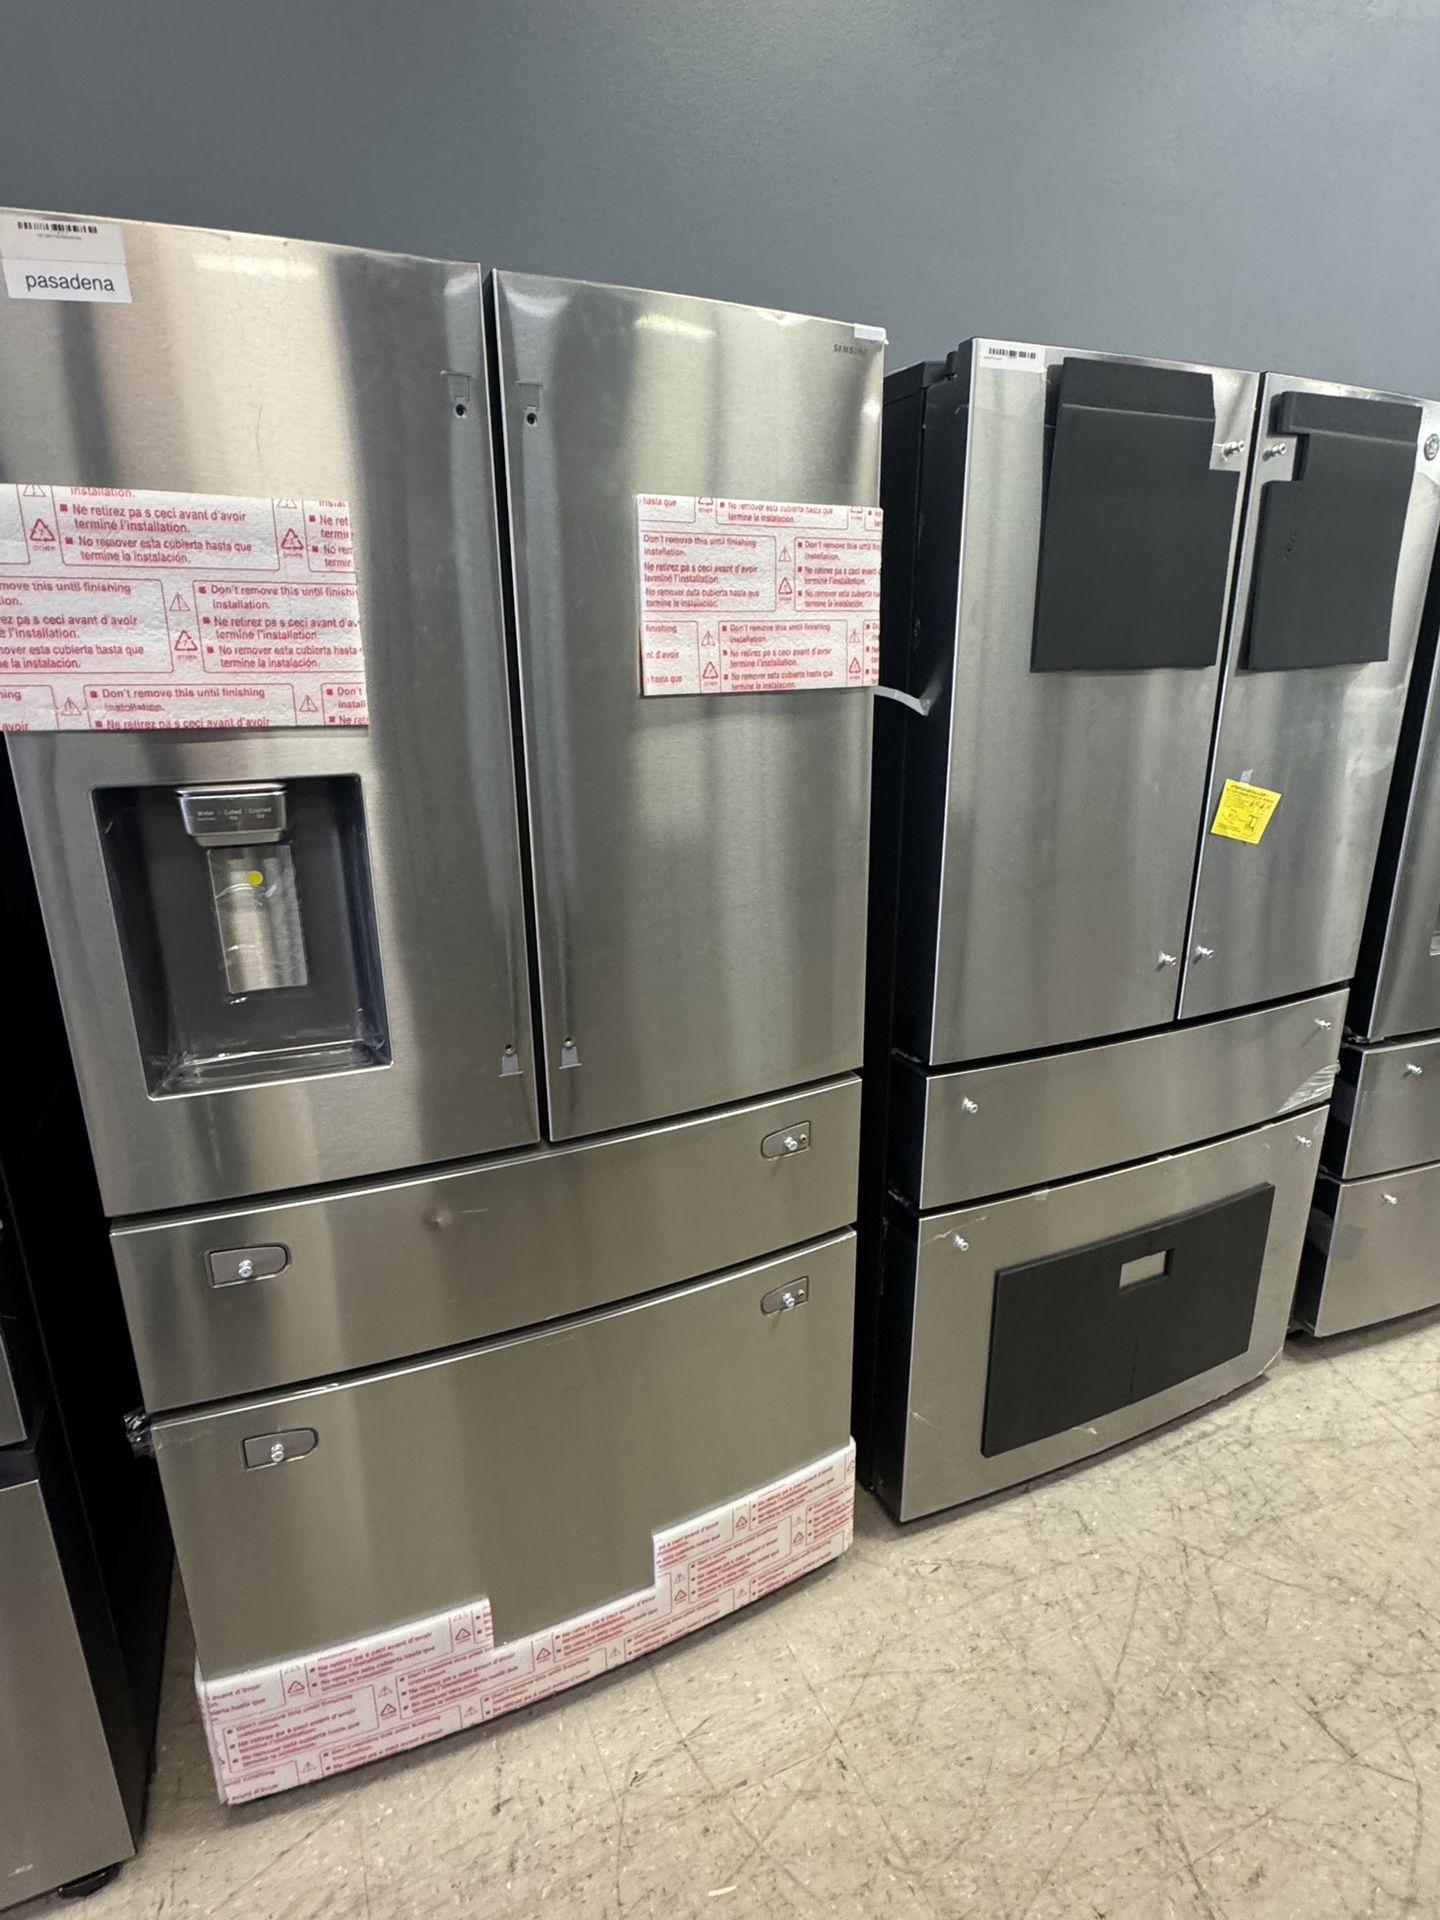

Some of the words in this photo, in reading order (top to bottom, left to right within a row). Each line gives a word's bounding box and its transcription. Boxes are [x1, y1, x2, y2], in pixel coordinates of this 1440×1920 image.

[25, 273, 115, 292] pasadena
[70, 487, 136, 498] installation.
[72, 503, 88, 515] Ne
[90, 504, 126, 517] retirez
[128, 507, 142, 519] pa
[144, 508, 152, 518] s
[154, 507, 176, 519] ceci
[178, 509, 208, 520] avant
[210, 509, 246, 521] d'avoir
[120, 519, 191, 533] l'installation.
[78, 536, 93, 547] No
[96, 538, 137, 548] remover
[139, 539, 161, 549] esta
[163, 539, 203, 551] cubierta
[205, 539, 232, 552] hasta
[233, 542, 253, 554] que
[643, 534, 663, 543] Don't
[665, 536, 693, 544] remove
[694, 536, 708, 545] this
[709, 537, 726, 545] until
[726, 538, 757, 548] finishing
[80, 549, 120, 561] termine
[121, 550, 131, 561] la
[643, 562, 654, 571] Ne
[655, 563, 679, 572] retirez
[713, 564, 733, 573] avant
[32, 581, 53, 591] this
[55, 581, 81, 592] until
[83, 581, 131, 595] finishing
[210, 584, 238, 594] Don't
[240, 586, 278, 596] remove
[280, 585, 299, 596] this
[301, 586, 323, 597] until
[212, 598, 271, 610] installation.
[16, 615, 30, 627] pa
[33, 615, 40, 625] s
[42, 614, 65, 625] ceci
[67, 615, 98, 625] avant
[100, 615, 138, 625] d'avoir
[213, 616, 228, 627] Ne
[230, 616, 262, 627] retirez
[264, 618, 277, 630] pa
[279, 618, 286, 627] s
[287, 617, 308, 628] ceci
[310, 618, 337, 628] avant
[8, 628, 80, 639] l'installation.
[29, 645, 51, 655] esta
[52, 645, 94, 655] cubierta
[95, 645, 123, 656] hasta
[125, 646, 144, 657] que
[218, 645, 233, 655] No
[234, 646, 272, 655] remover
[274, 646, 294, 655] esta
[295, 645, 332, 655] cubierta
[333, 646, 358, 656] hasta
[10, 657, 21, 668] la
[220, 658, 255, 668] termine
[257, 658, 266, 668] la
[102, 688, 131, 698] Don't
[133, 689, 173, 698] remove
[174, 687, 195, 698] this
[196, 687, 220, 698] until
[222, 686, 265, 699] finishing
[337, 686, 362, 696] Don't
[106, 719, 120, 730] Ne
[123, 719, 156, 729] retirez
[183, 717, 204, 729] ceci
[206, 717, 234, 728] avant
[236, 717, 270, 728] d'avoir
